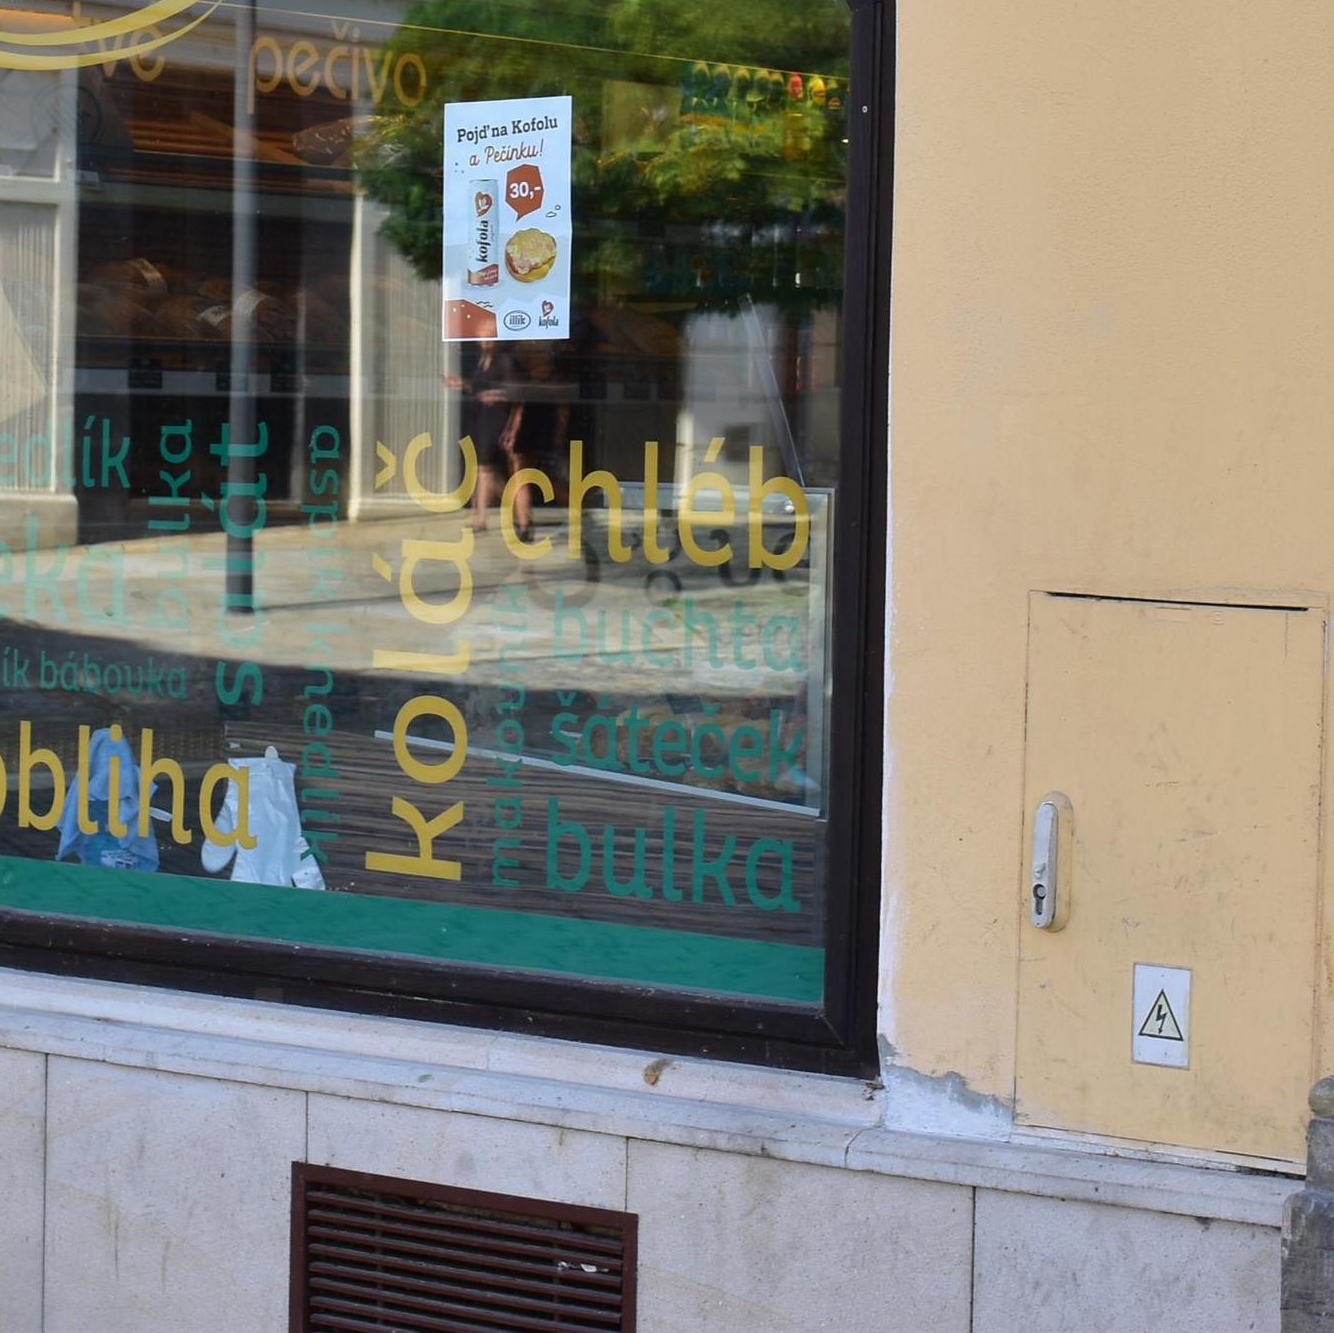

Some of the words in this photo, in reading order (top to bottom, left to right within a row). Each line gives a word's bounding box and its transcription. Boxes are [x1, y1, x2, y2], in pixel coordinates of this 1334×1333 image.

[246, 17, 427, 114] pečivo
[457, 125, 489, 145] Pojď
[491, 124, 508, 138] na
[511, 116, 559, 134] Kofolu
[469, 155, 480, 167] a
[509, 181, 542, 200] 30,-
[475, 219, 490, 264] kofola
[499, 436, 812, 571] chléb
[200, 420, 270, 706] salát
[365, 430, 480, 882] koláč
[552, 588, 806, 674] buchta
[550, 690, 805, 787] šáteček
[546, 796, 803, 915] bulka
